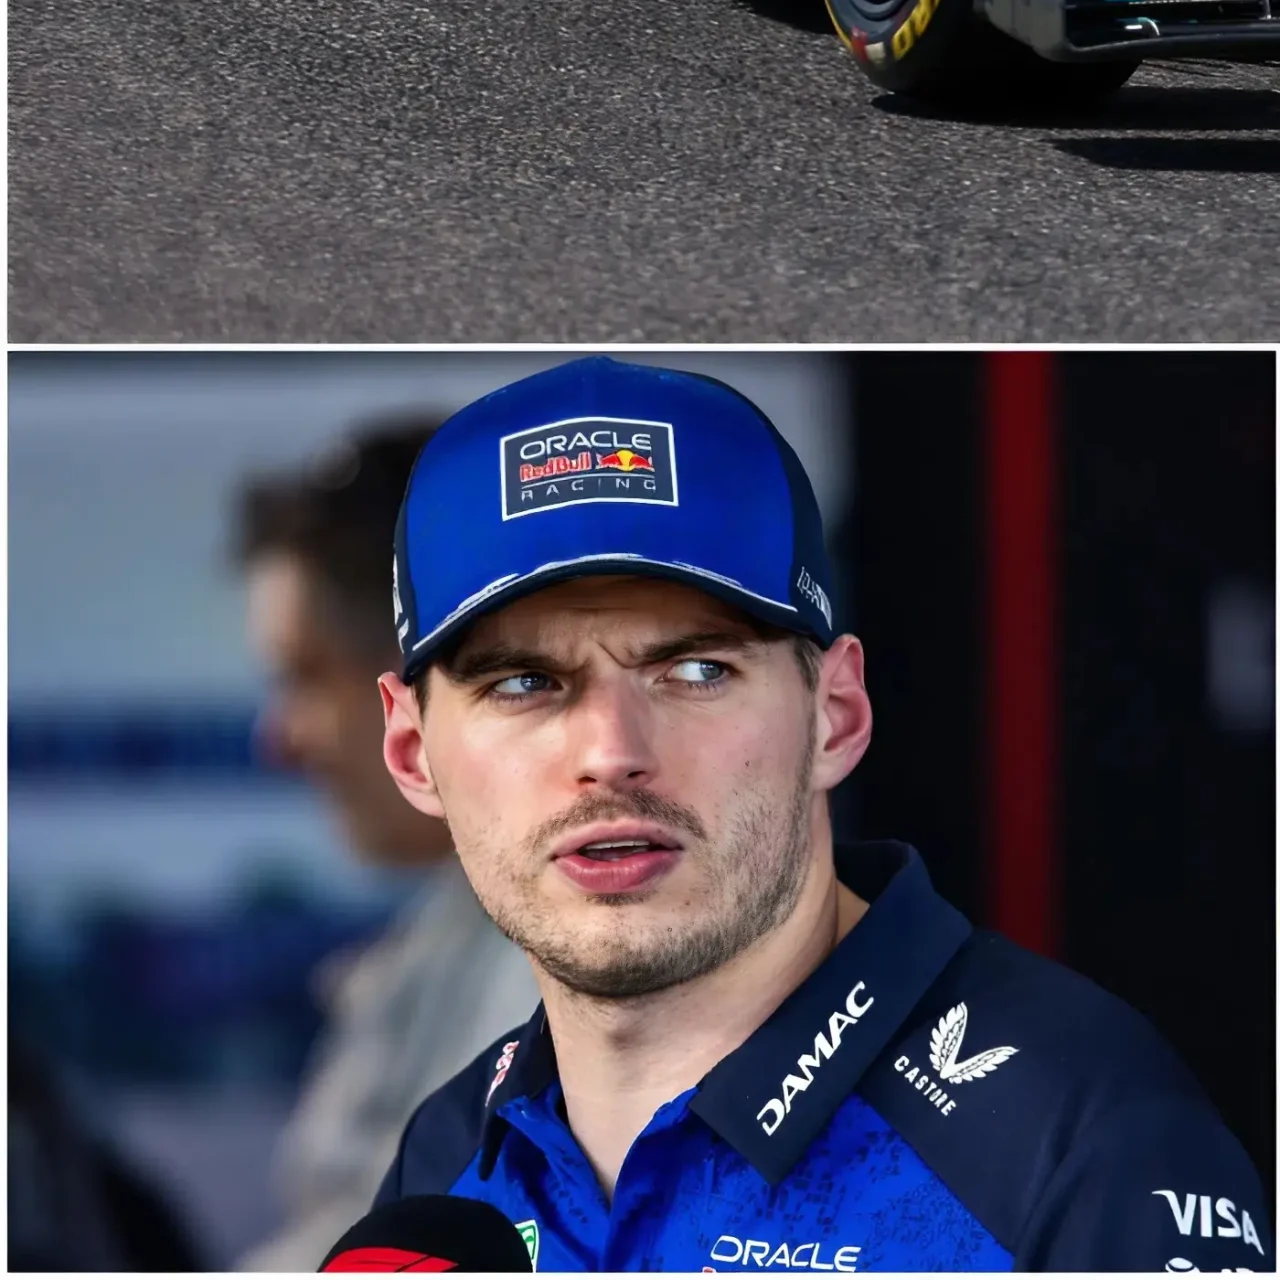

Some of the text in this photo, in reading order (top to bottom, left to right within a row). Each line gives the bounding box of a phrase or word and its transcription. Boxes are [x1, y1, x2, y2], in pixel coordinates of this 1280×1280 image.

[519, 430, 652, 460] ORACLE
[521, 478, 657, 502] RACING
[756, 980, 875, 1137] DAMAC
[894, 1054, 957, 1117] CASTORE
[1151, 1189, 1265, 1256] VISA
[709, 1234, 862, 1272] ORACLE
